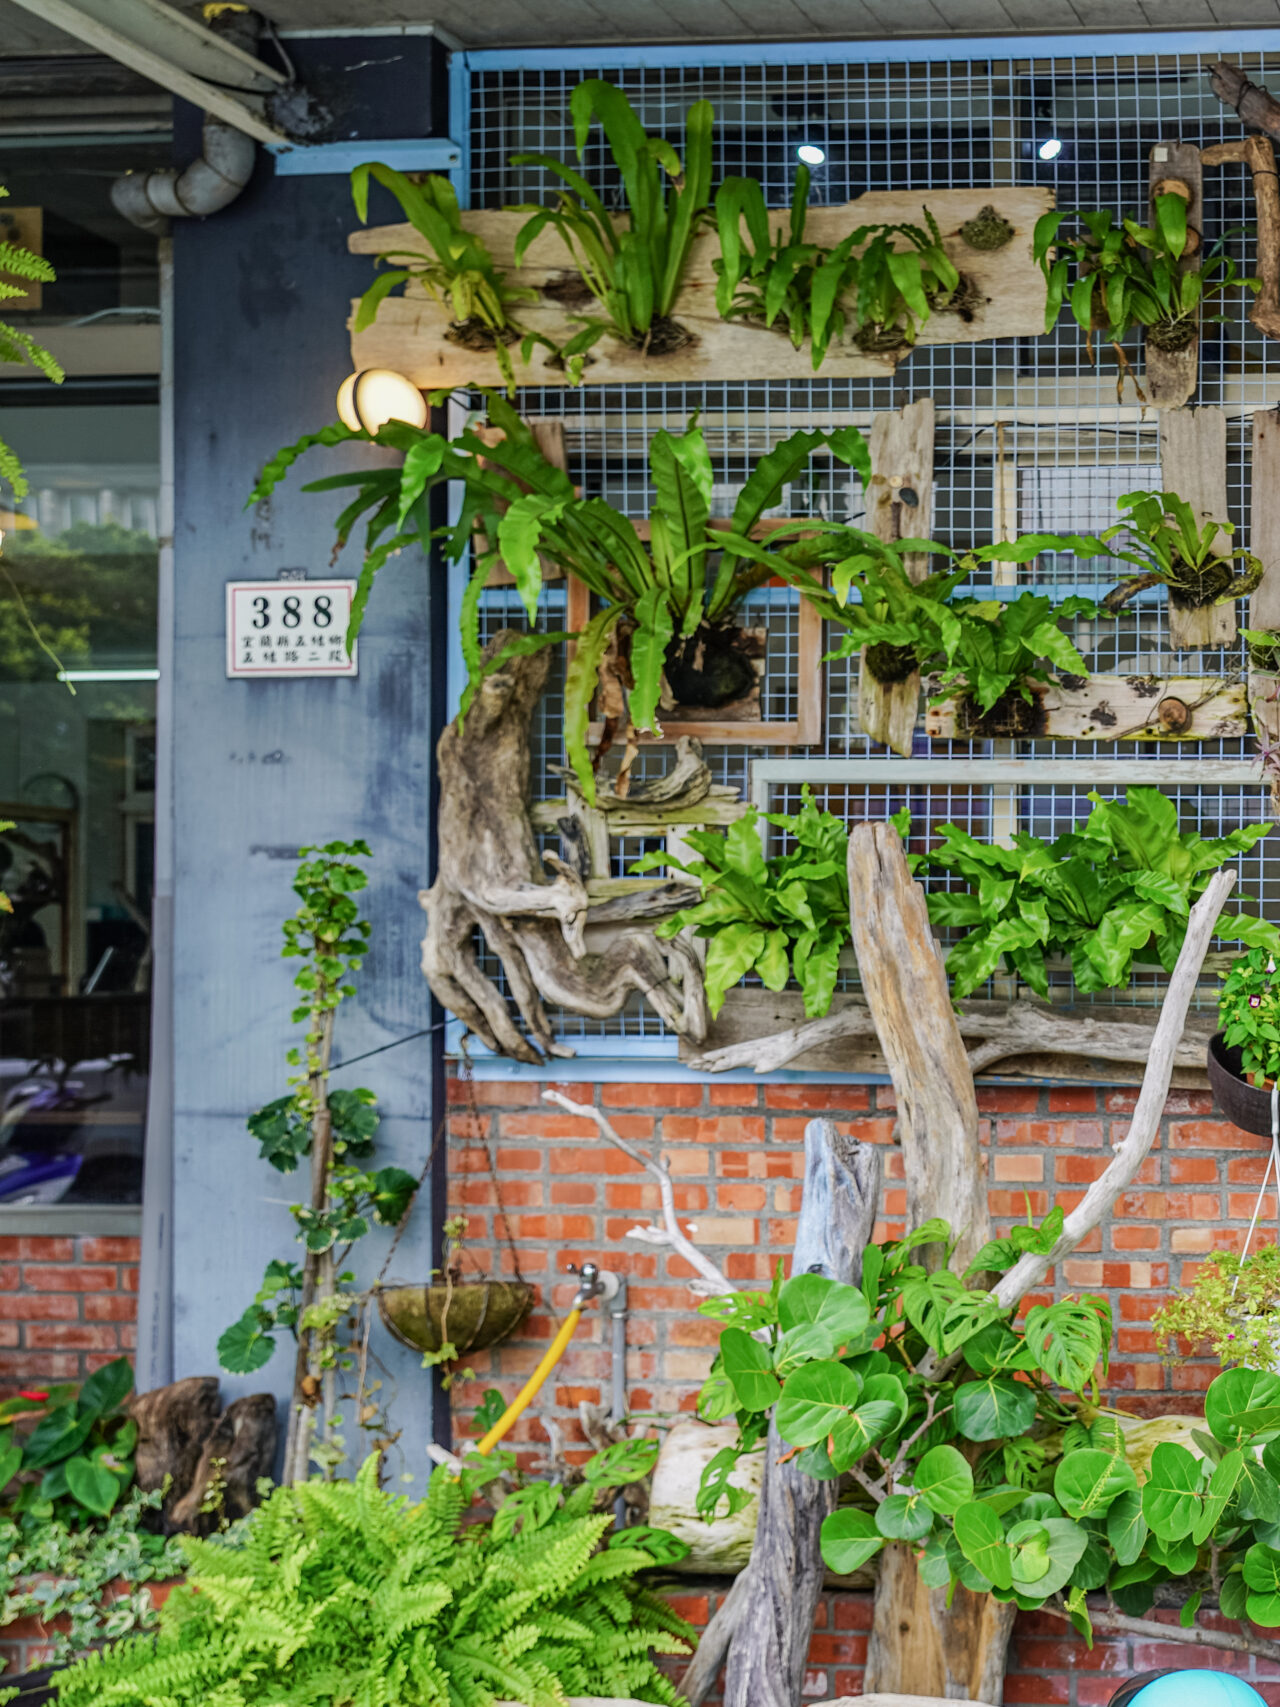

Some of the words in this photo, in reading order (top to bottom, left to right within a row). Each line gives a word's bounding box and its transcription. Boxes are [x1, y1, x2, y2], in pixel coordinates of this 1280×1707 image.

[252, 595, 332, 629] 388
[242, 650, 343, 664] 五結路二段
